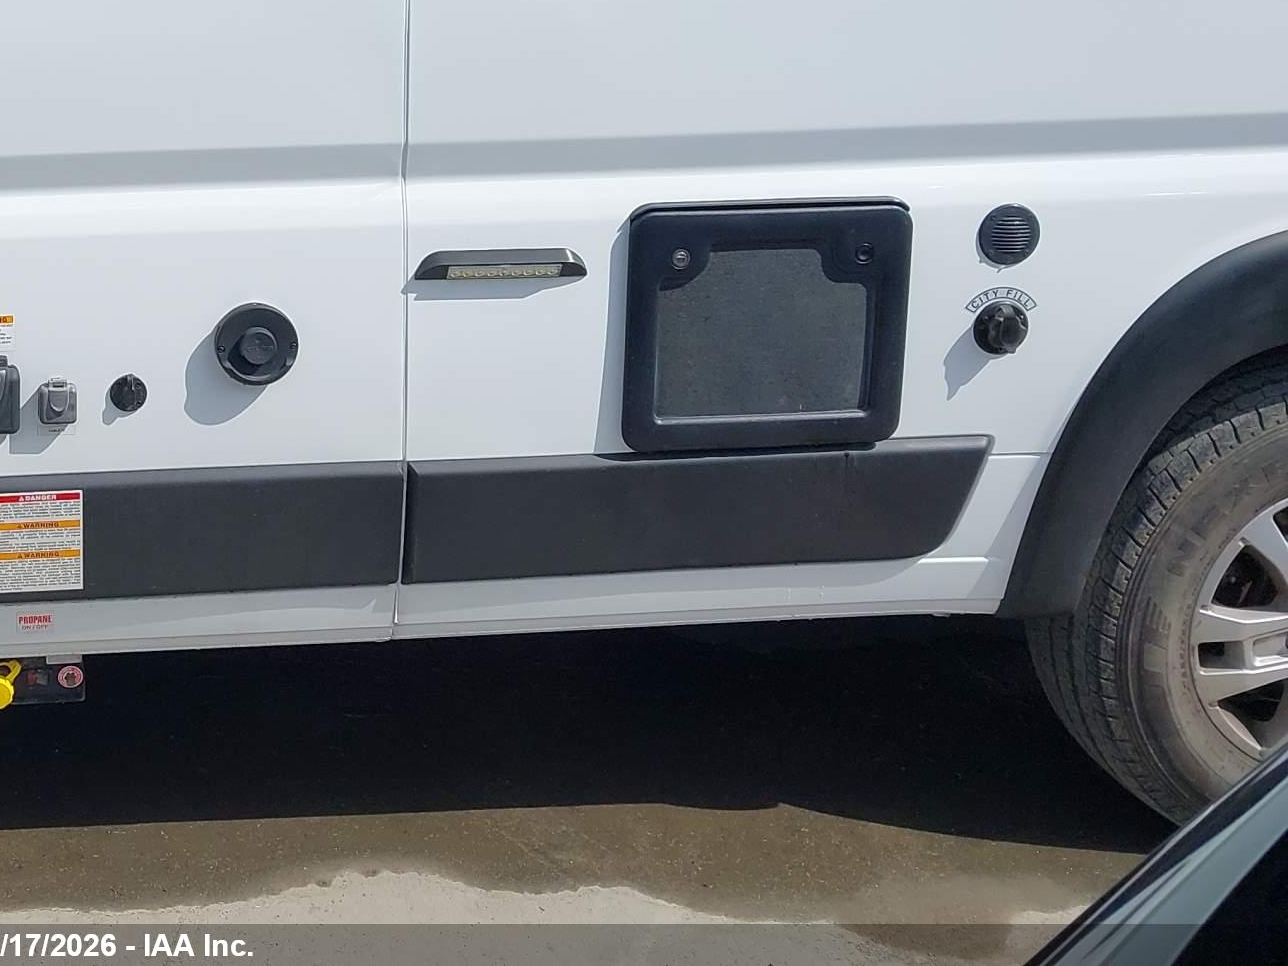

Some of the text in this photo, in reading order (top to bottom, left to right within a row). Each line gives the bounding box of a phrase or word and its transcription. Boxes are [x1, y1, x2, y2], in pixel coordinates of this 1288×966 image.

[971, 289, 1031, 309] CITY FILL
[23, 551, 60, 559] WARNING
[18, 615, 52, 624] PROPANE
